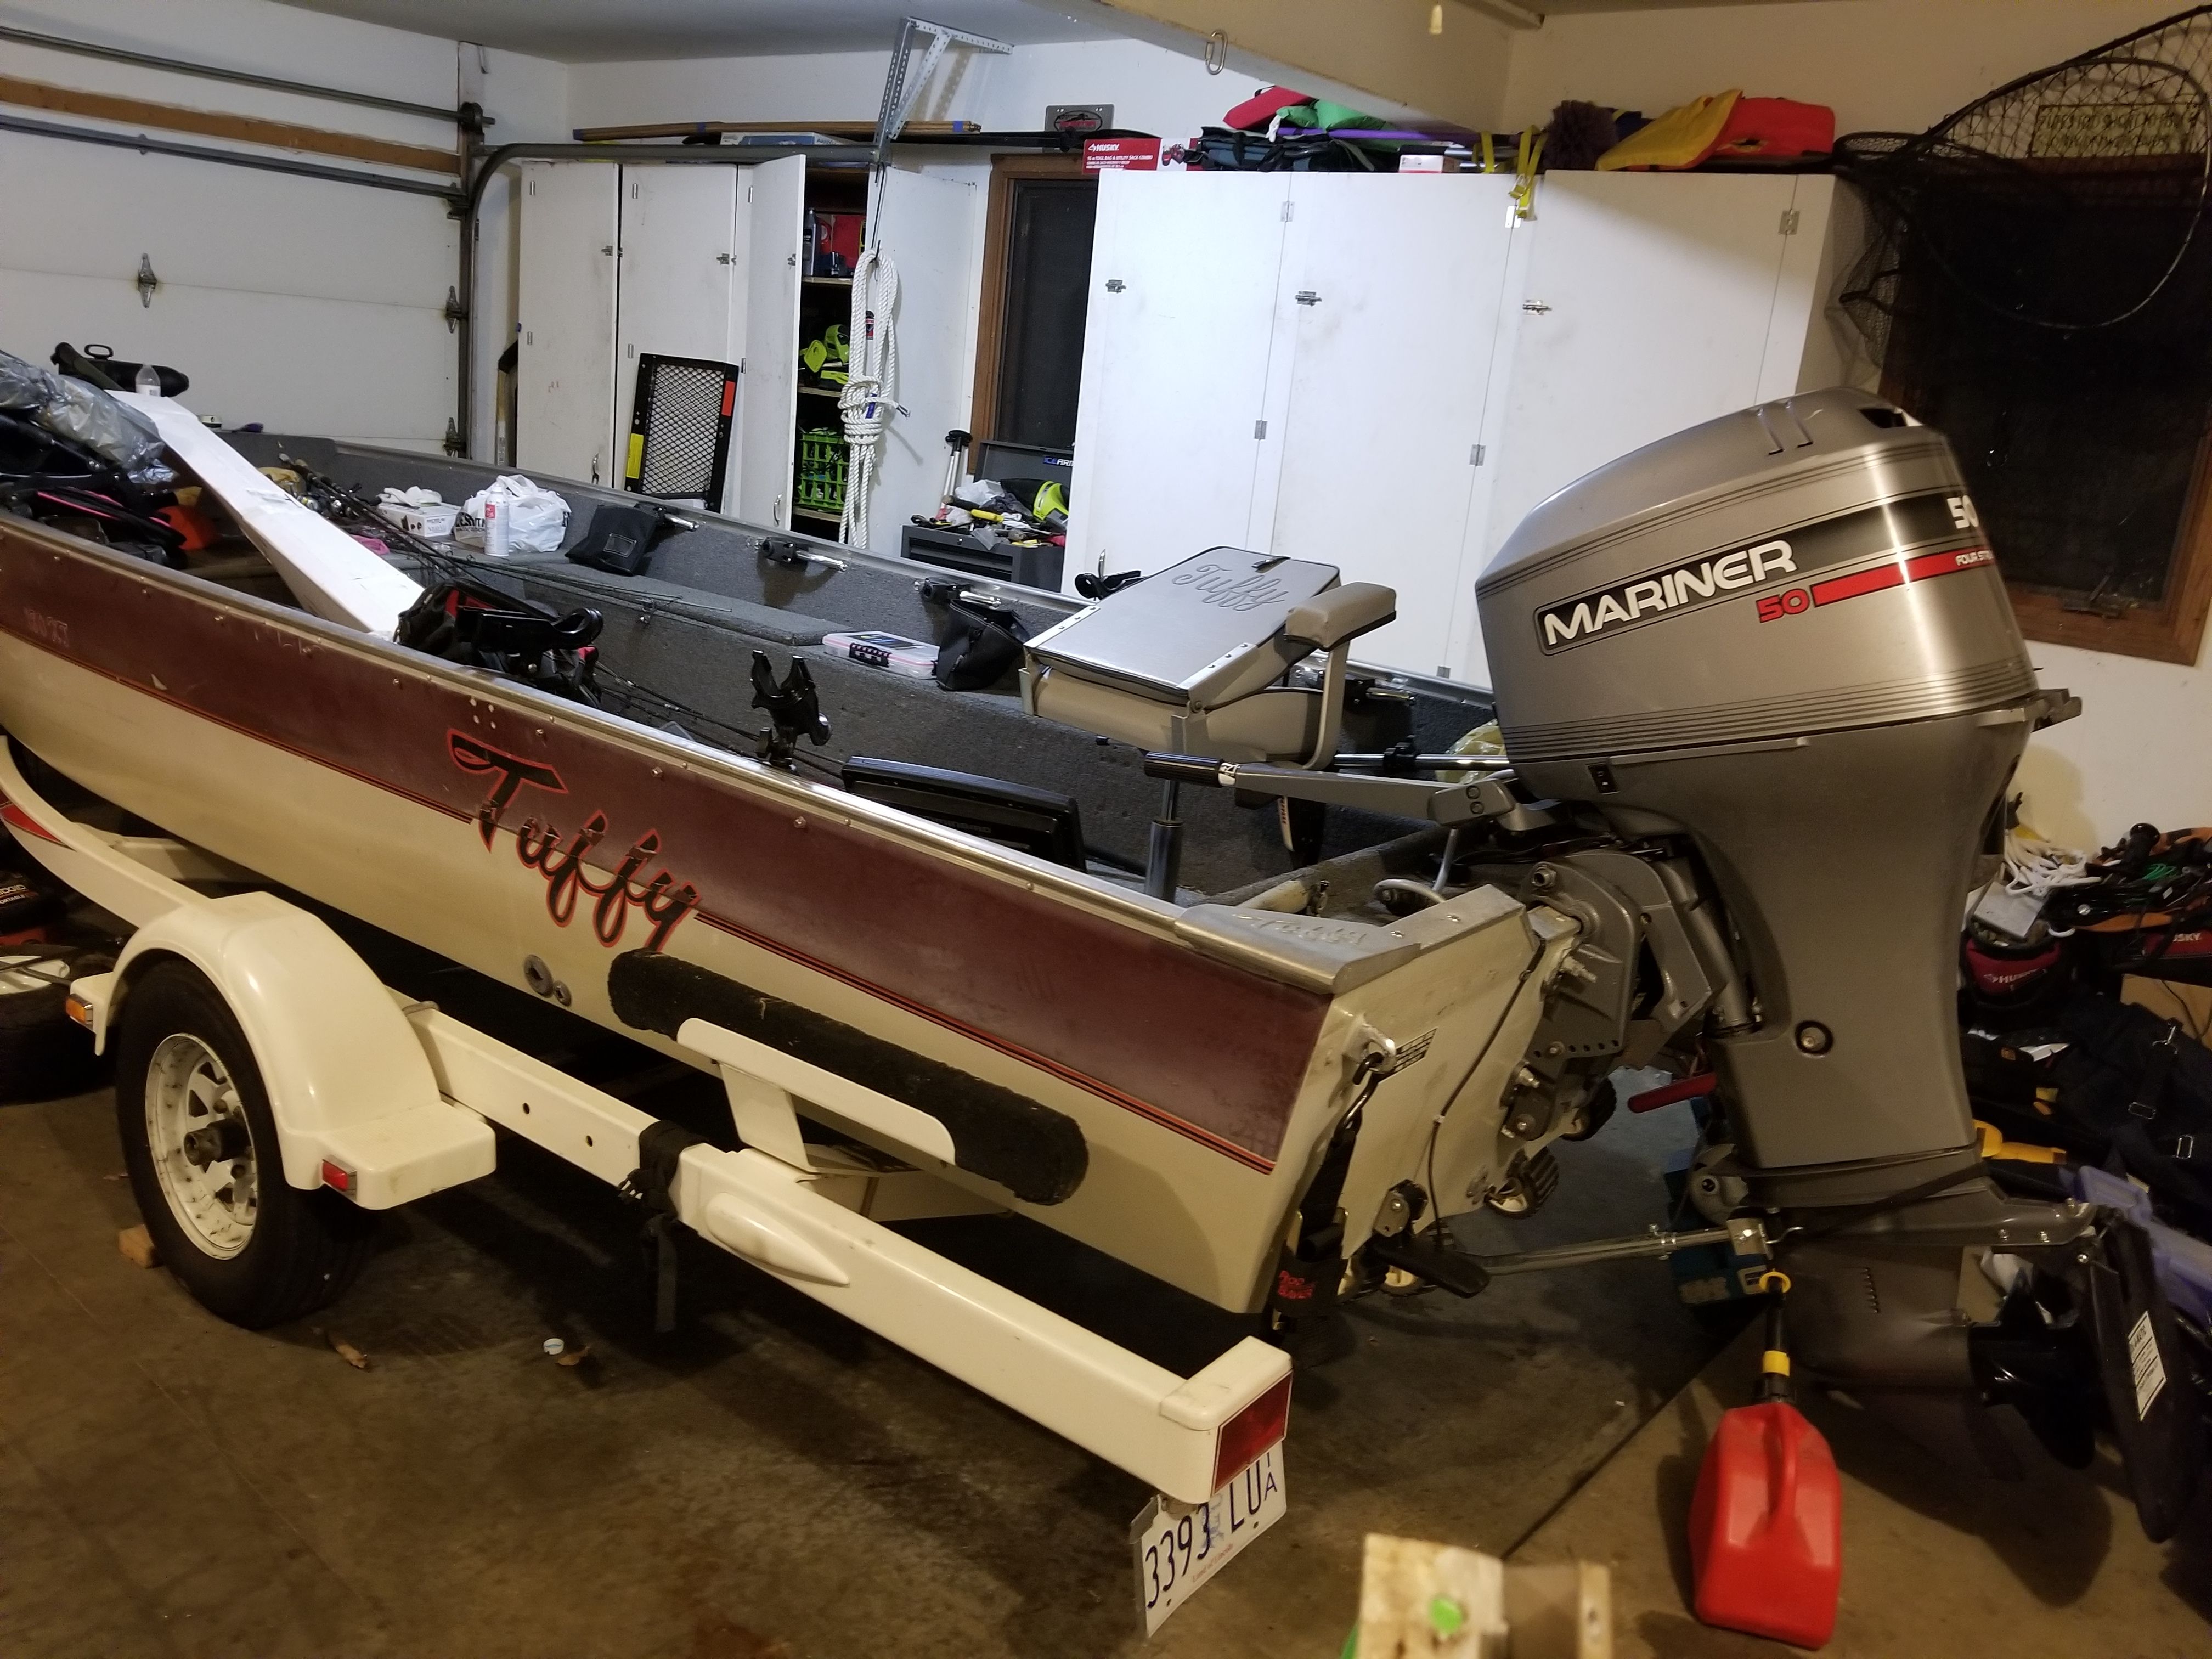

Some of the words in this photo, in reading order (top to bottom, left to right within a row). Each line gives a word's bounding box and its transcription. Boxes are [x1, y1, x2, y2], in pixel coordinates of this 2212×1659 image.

[1947, 495, 1979, 529] 50
[1172, 564, 1289, 611] Tuffy
[1543, 540, 1797, 646] MARINER
[1756, 588, 1809, 623] 50
[447, 728, 702, 952] Tuffy
[2172, 932, 2202, 942] USKY
[1145, 1502, 1210, 1609] 3393
